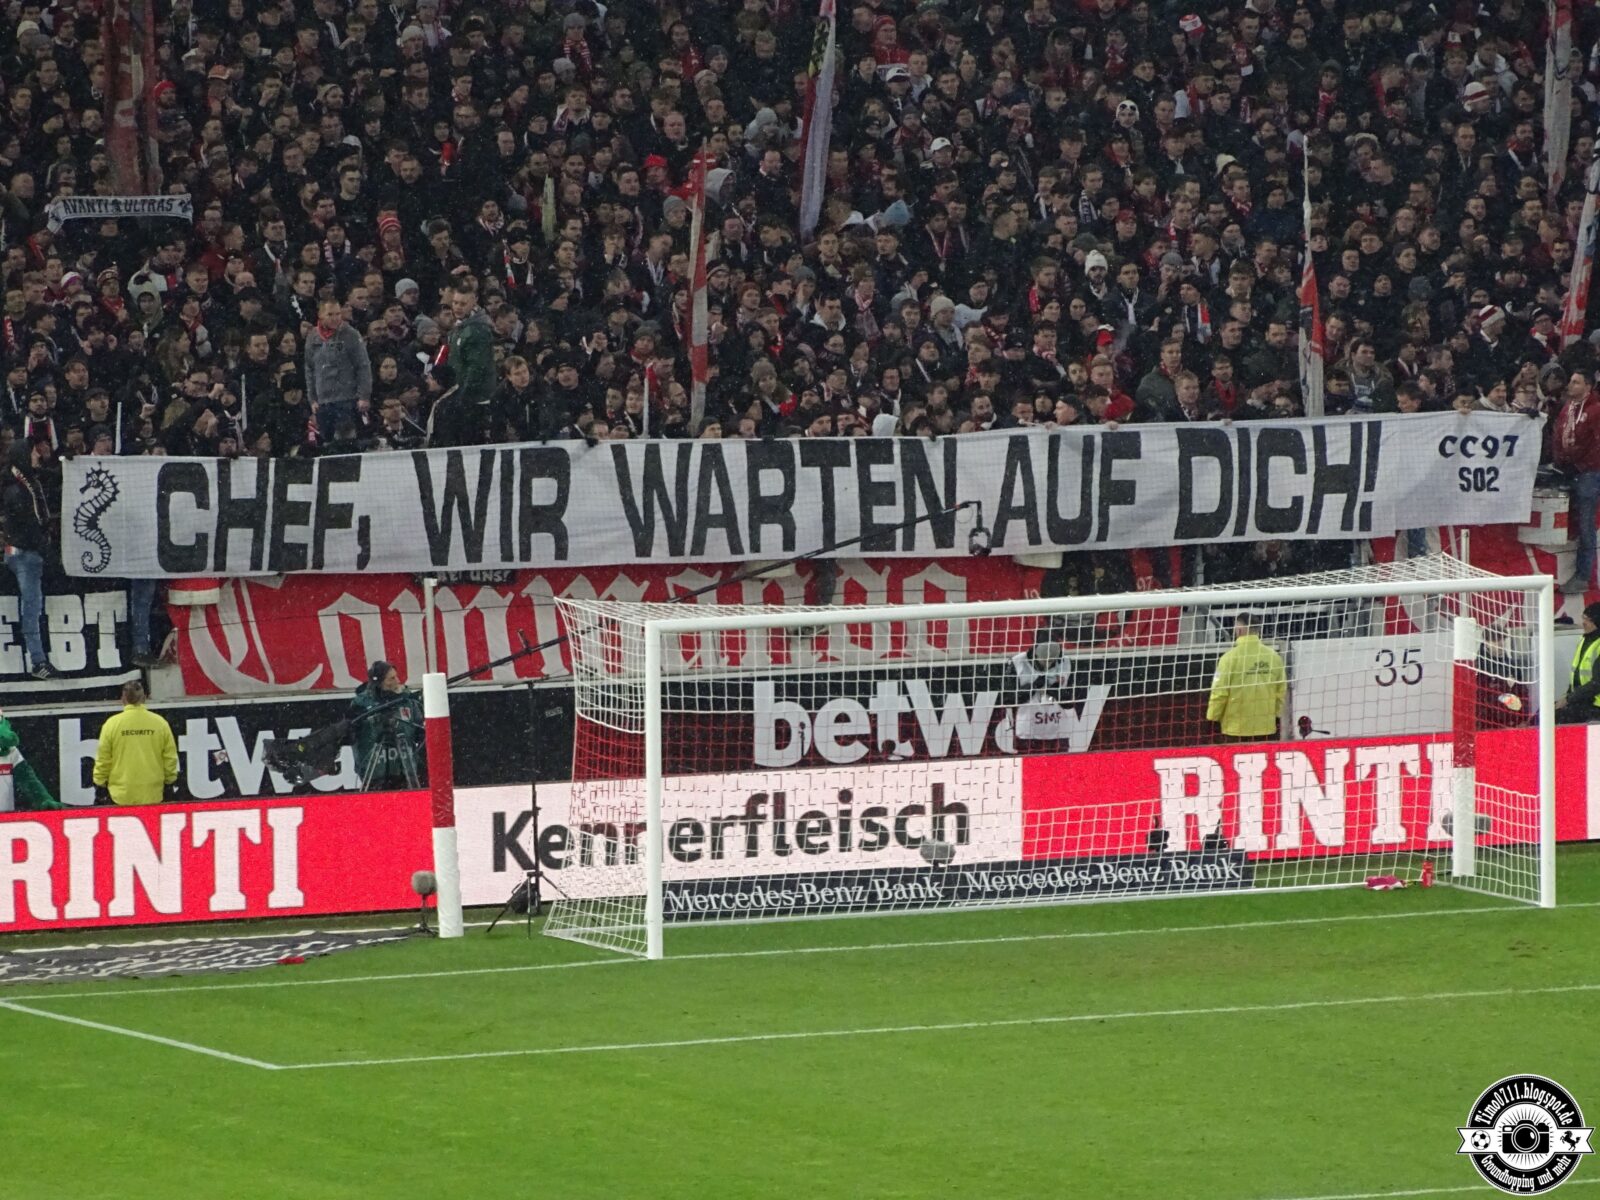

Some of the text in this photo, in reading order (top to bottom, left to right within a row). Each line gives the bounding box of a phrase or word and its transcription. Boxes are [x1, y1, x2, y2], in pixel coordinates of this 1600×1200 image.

[64, 199, 173, 214] AVANTI ULTRAS
[1438, 433, 1519, 459] CC97
[157, 421, 1382, 573] CHEF, WIR WARTEN AUF DICH!
[1375, 649, 1423, 687] 35
[121, 729, 155, 737] SECURITY
[1153, 742, 1454, 852] RINTI
[0, 806, 304, 923] RINTI
[964, 857, 1241, 893] Mercedes-Benz Bank
[667, 876, 944, 912] Mercedes-Benz Bank
